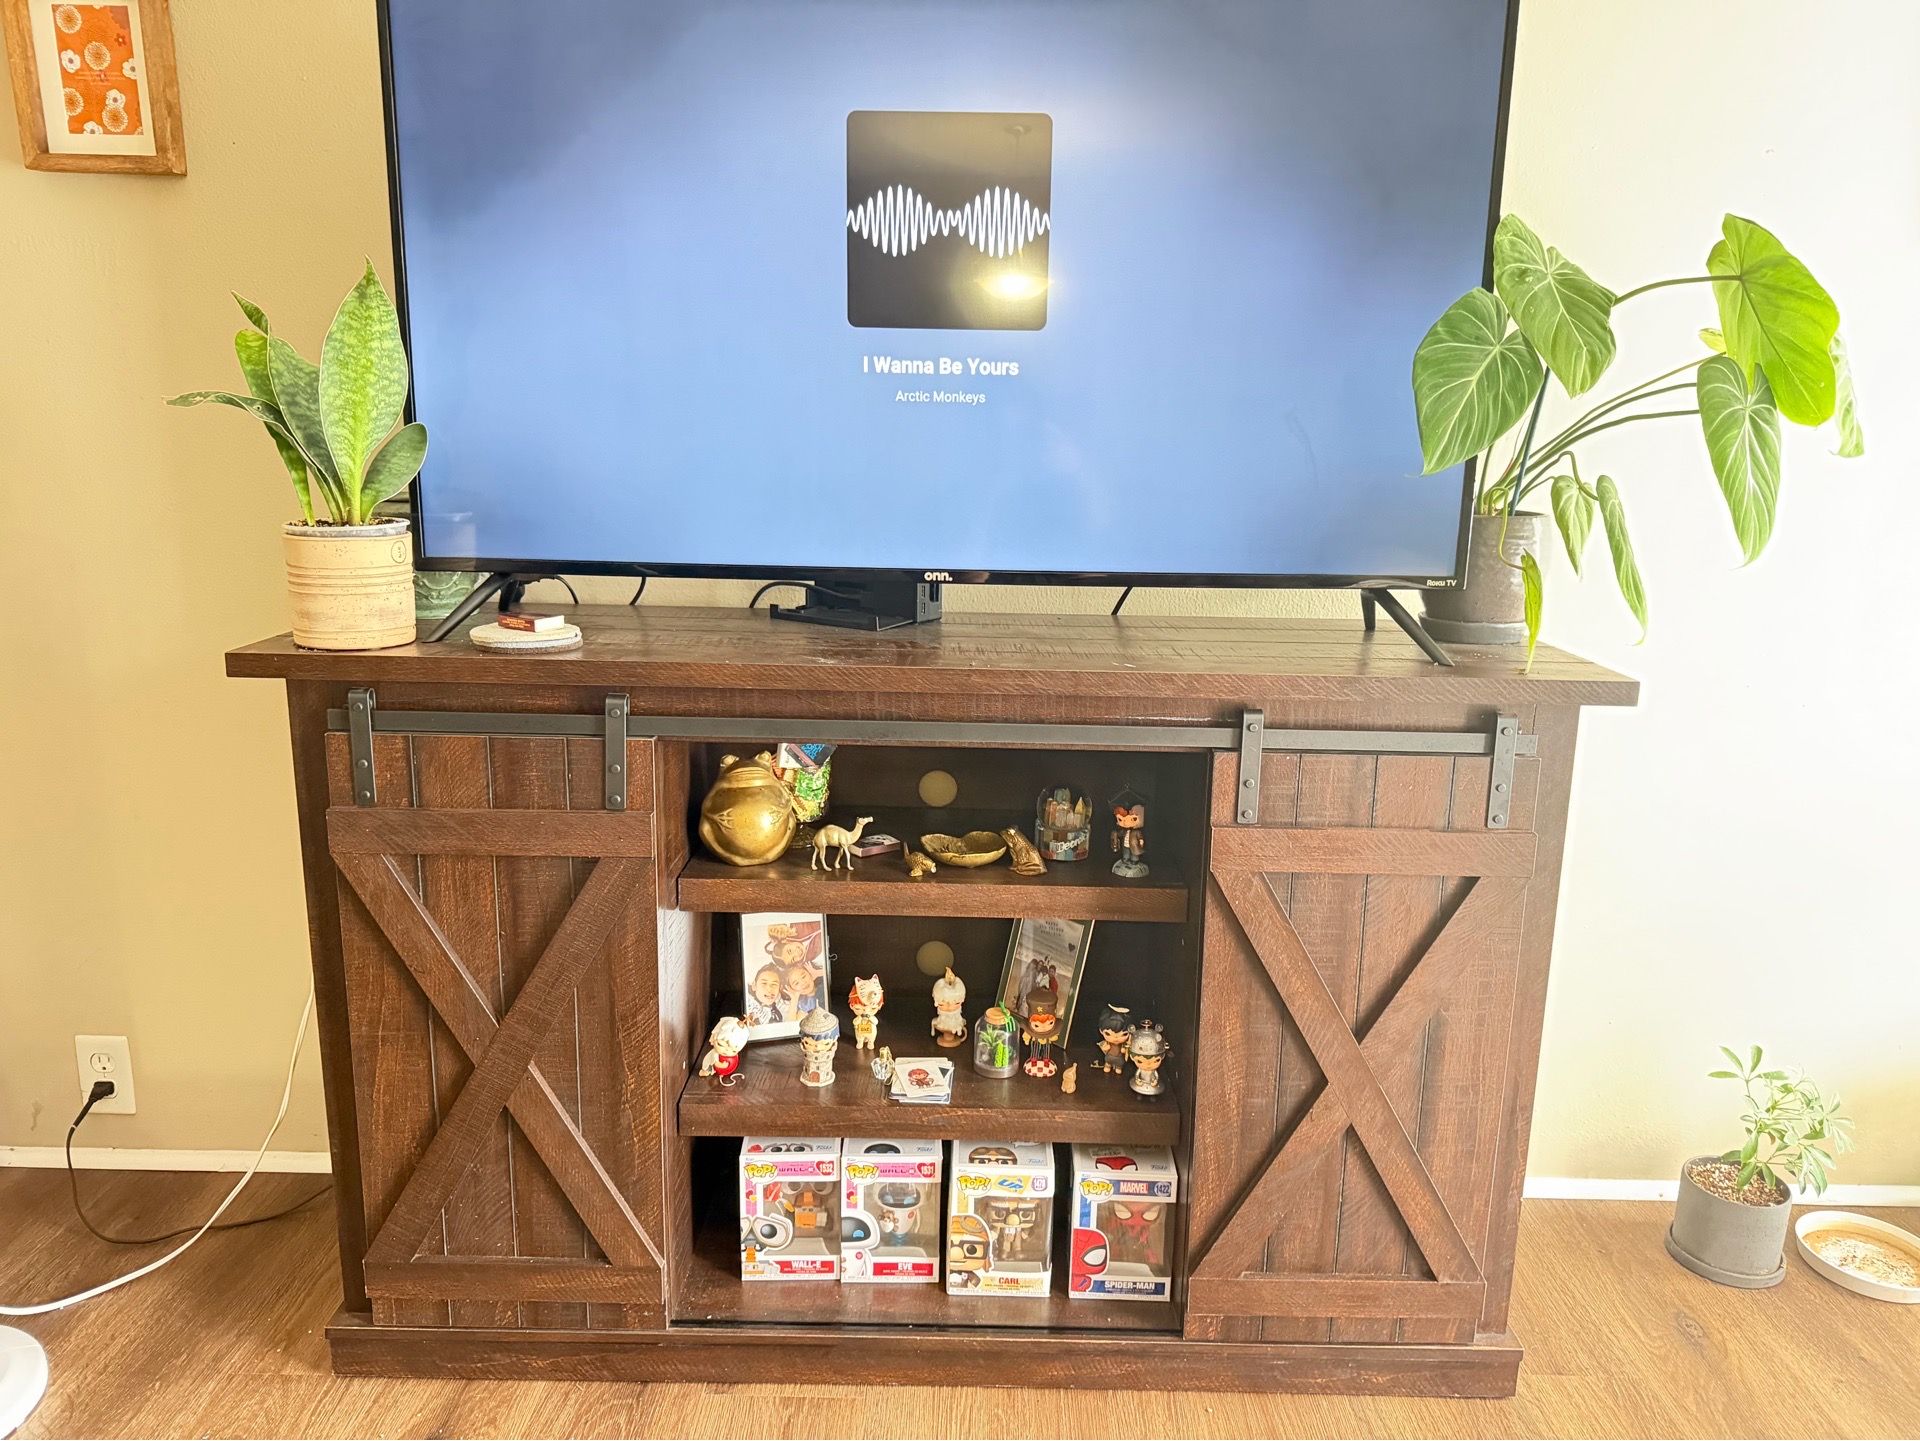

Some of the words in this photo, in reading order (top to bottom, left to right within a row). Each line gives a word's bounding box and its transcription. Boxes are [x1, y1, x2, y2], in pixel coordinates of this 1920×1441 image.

[863, 356, 869, 373] I
[873, 356, 934, 374] Wanna
[939, 357, 963, 375] Be
[967, 358, 1019, 376] Yours
[895, 390, 930, 402] Arctic
[933, 390, 986, 405] Monkeys
[924, 571, 953, 582] onn.
[1446, 579, 1457, 587] TV
[1119, 1181, 1149, 1194] MARVEL
[1155, 1184, 1170, 1194] 1422
[792, 1260, 821, 1268] WALL-E
[898, 1262, 913, 1270] EVE
[998, 1277, 1020, 1285] CARL
[1104, 1280, 1155, 1290] SPIDER-MAN
